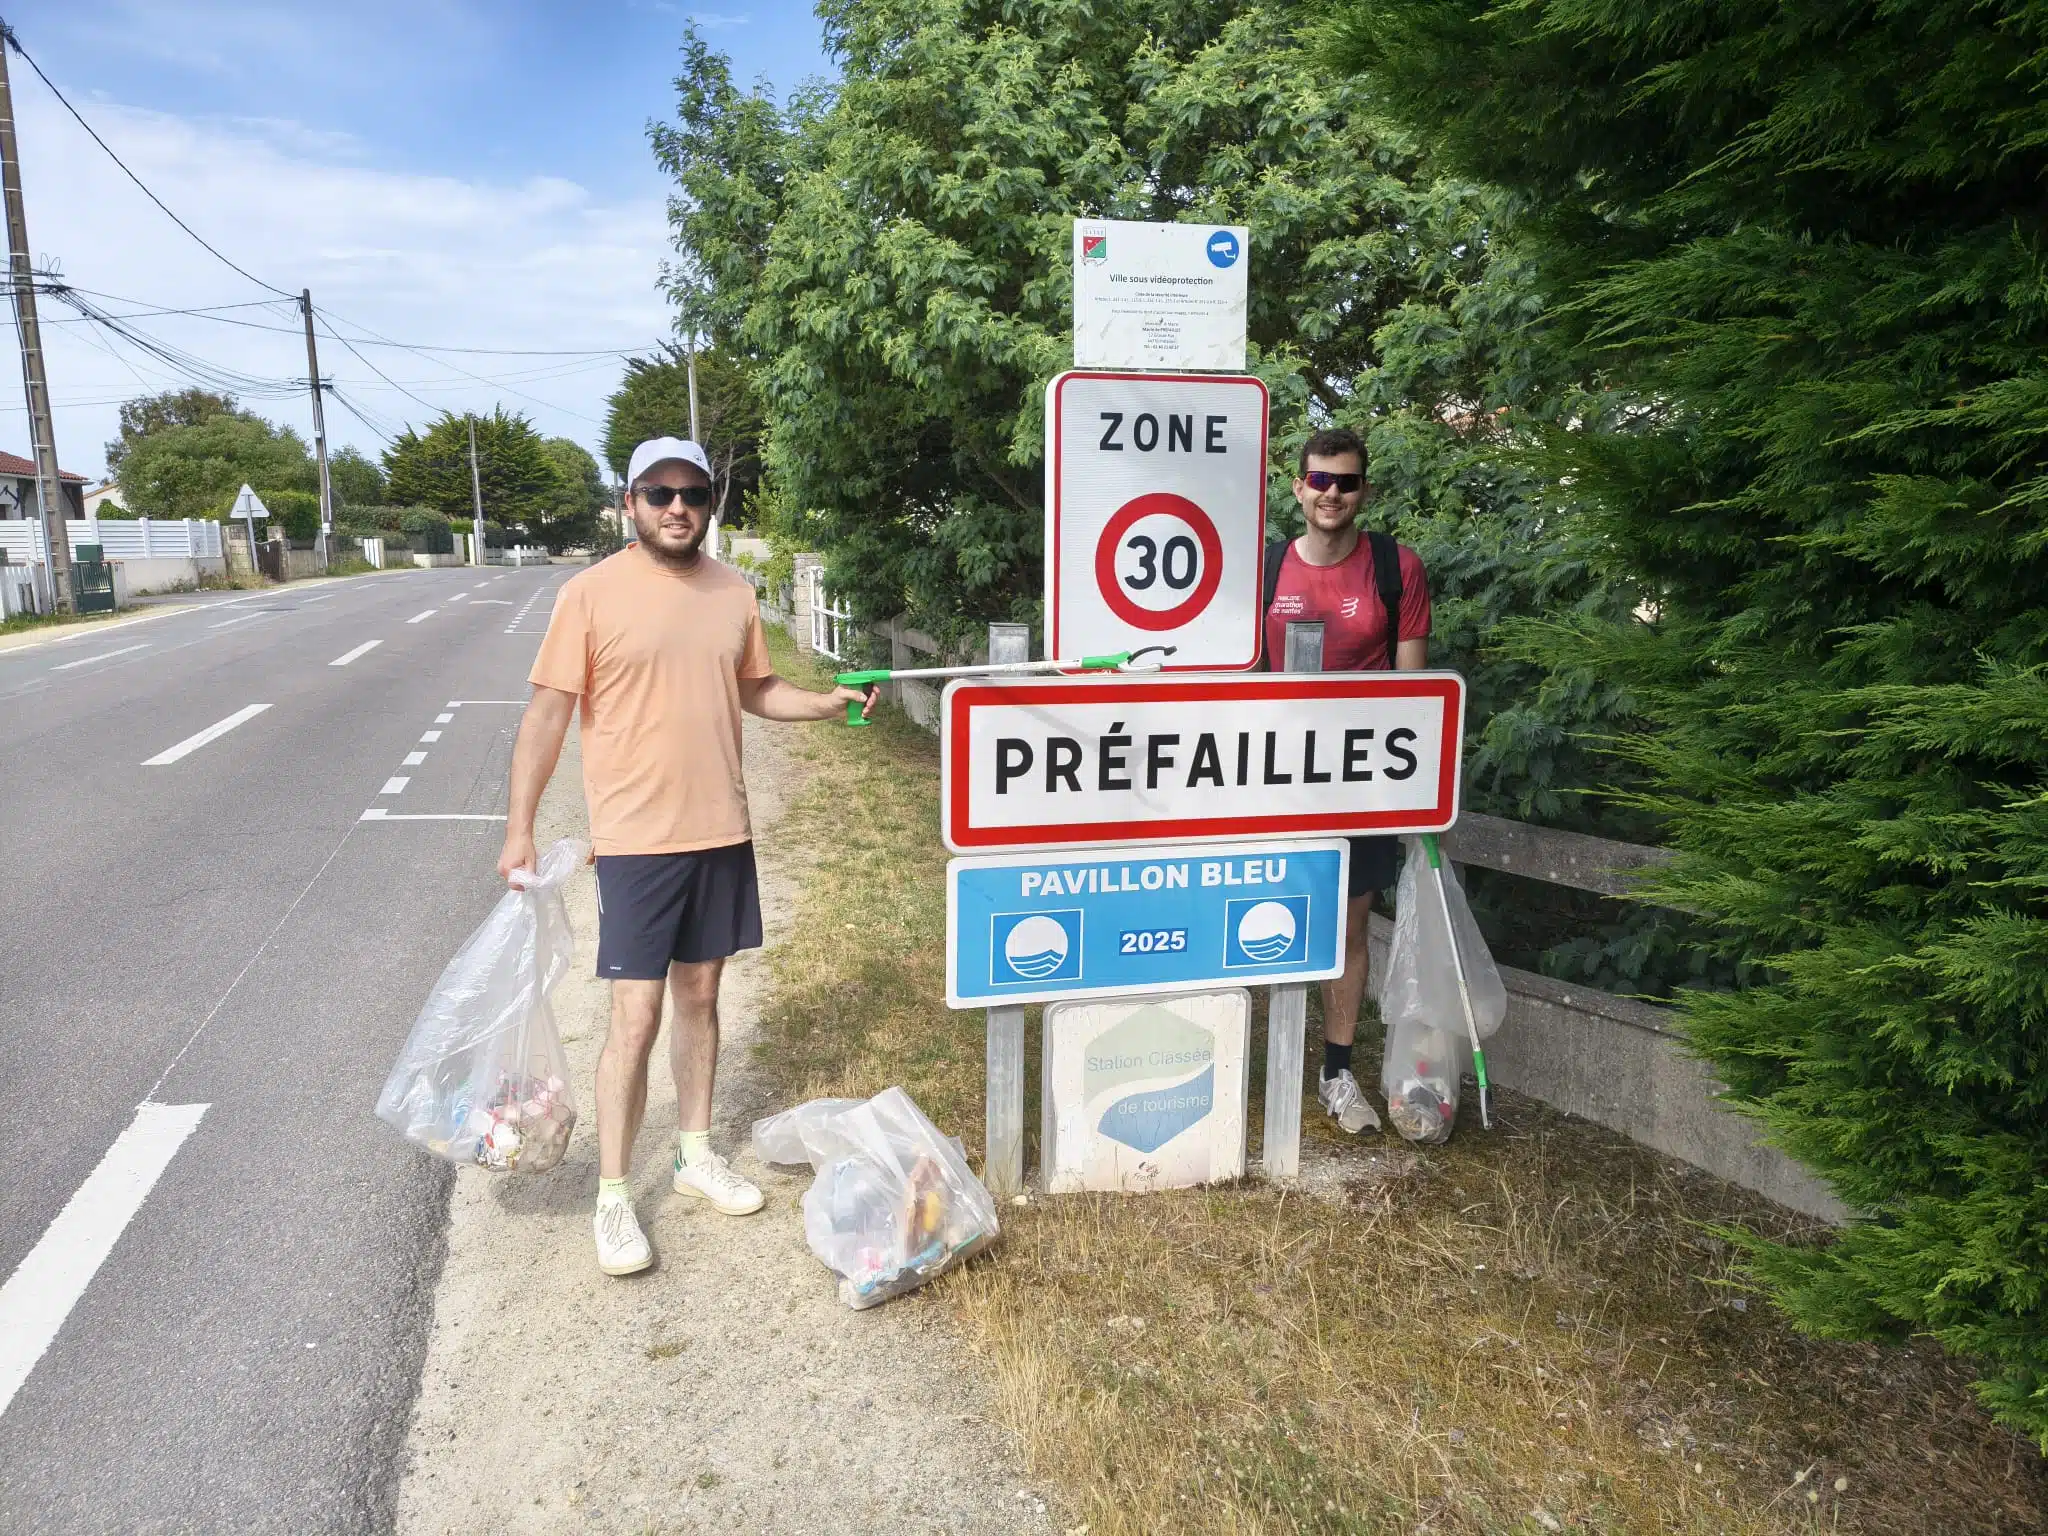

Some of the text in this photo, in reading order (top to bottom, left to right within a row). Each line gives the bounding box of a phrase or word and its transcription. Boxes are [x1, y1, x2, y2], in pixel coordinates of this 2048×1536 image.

[1109, 273, 1214, 286] Ville sous vidéoprotection
[1099, 412, 1228, 453] ZONE
[1124, 535, 1198, 590] 30
[995, 721, 1419, 795] PRÉFAILLES
[1021, 858, 1288, 898] PAVILLON BLEU
[1121, 929, 1187, 954] 2025
[1087, 1047, 1211, 1072] Station Classée
[1118, 1095, 1210, 1115] de tourisme
